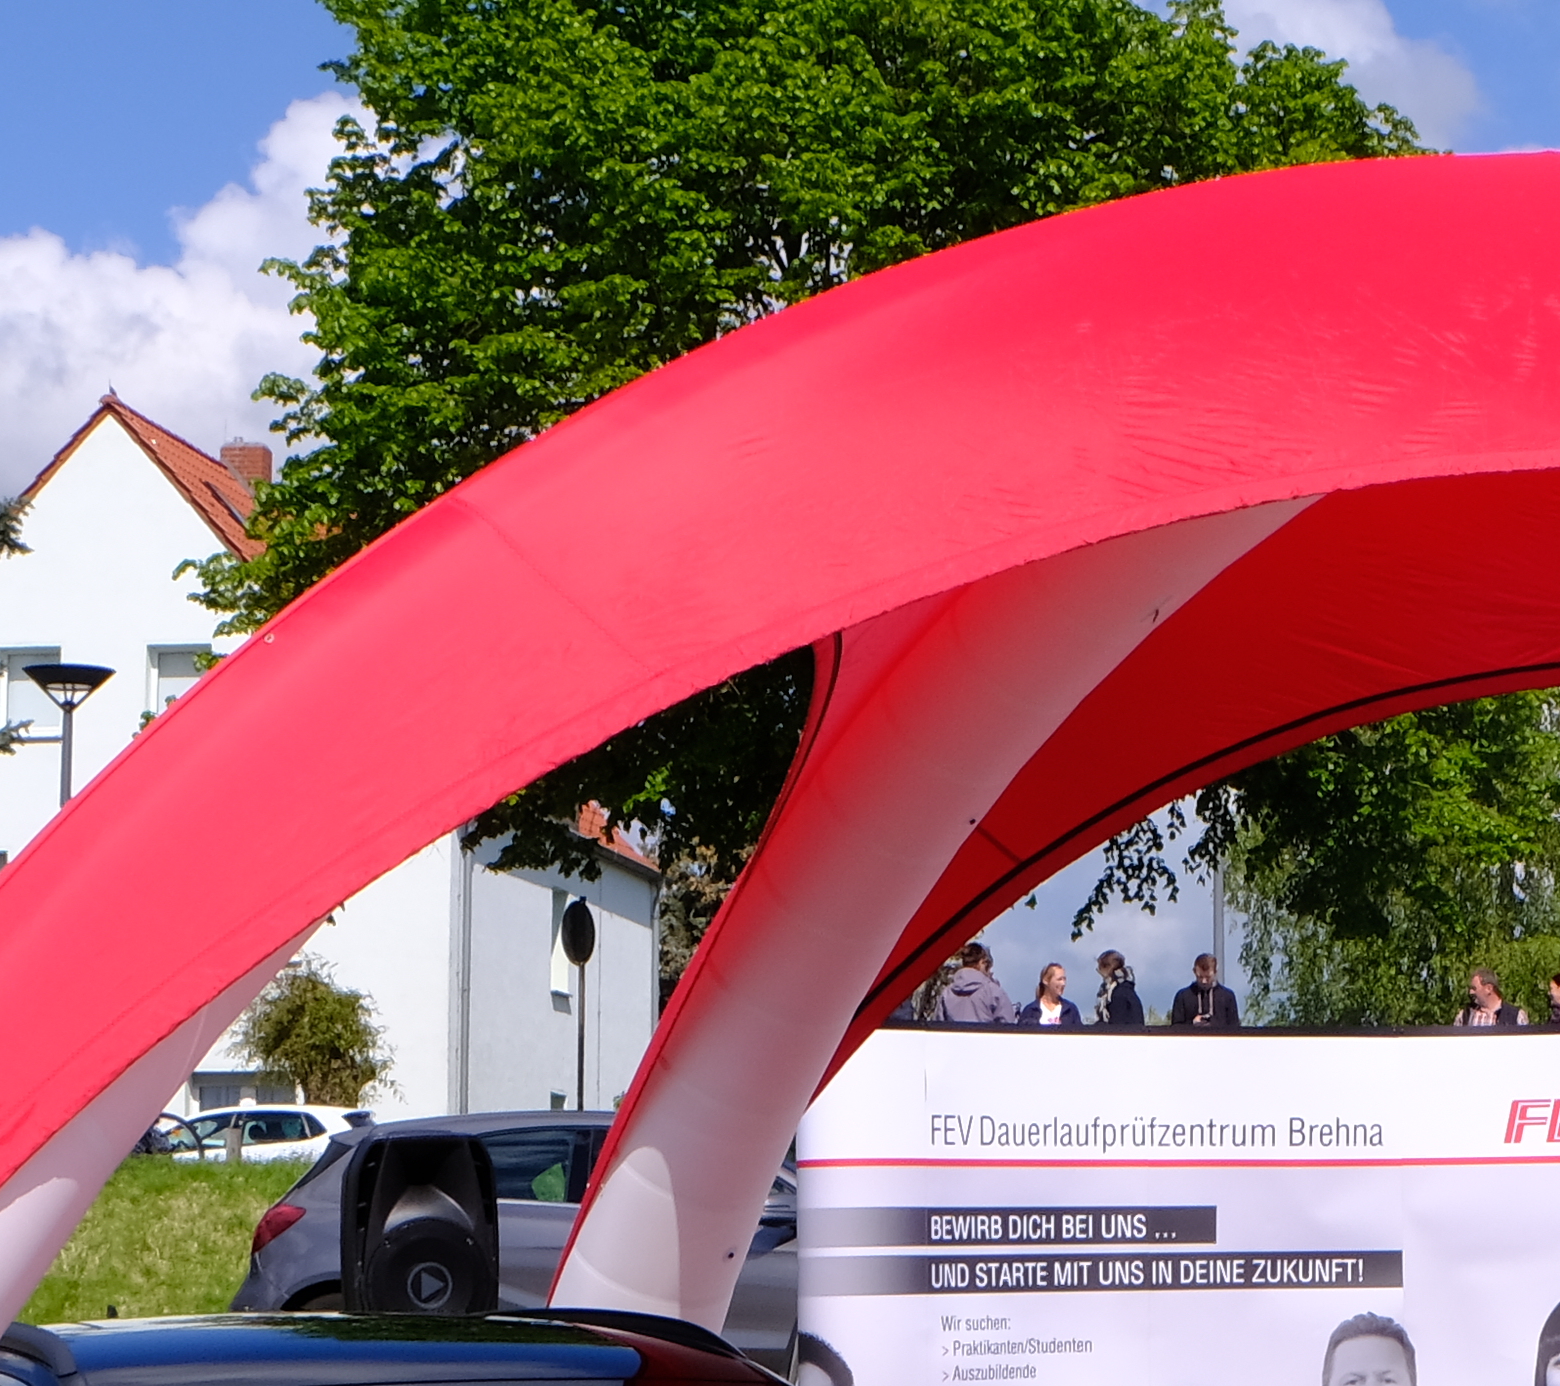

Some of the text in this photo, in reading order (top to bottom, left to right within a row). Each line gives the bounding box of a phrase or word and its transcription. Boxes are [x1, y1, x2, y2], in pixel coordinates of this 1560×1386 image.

[930, 1115, 1384, 1154] FEV Dauerlaufprüfzentrum Brehna
[930, 1215, 1002, 1240] BEWIRB
[1008, 1215, 1055, 1240] DICH
[1061, 1214, 1094, 1239] BEI
[1101, 1213, 1147, 1239] UNS
[930, 1258, 1364, 1288] UND STARTE MIT UNS IN DEINE ZUKUNFT!
[941, 1315, 1011, 1331] Wir suchen:
[952, 1338, 1093, 1357] Praktikanten/Studenten
[952, 1364, 1037, 1381] Auszubildende
